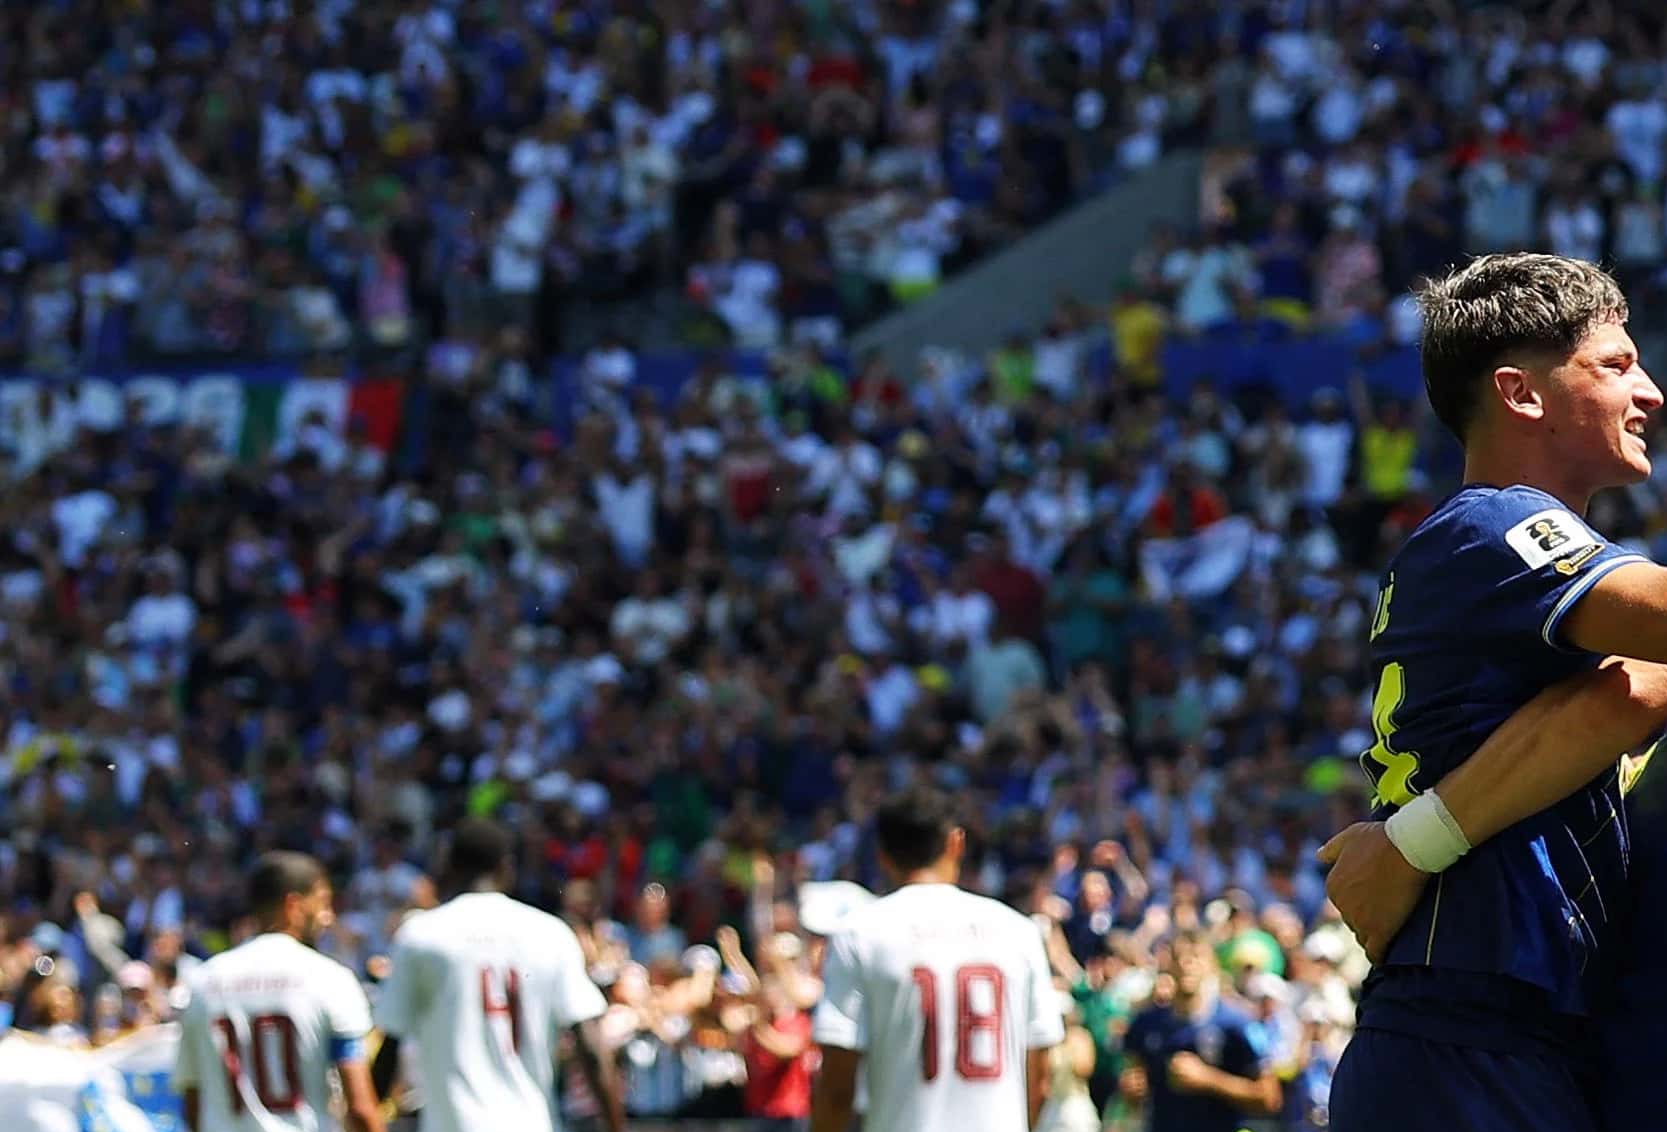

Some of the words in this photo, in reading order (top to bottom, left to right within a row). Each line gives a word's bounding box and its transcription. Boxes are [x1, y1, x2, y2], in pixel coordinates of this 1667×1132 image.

[481, 966, 520, 1056] 4
[912, 964, 1005, 1081] 18
[213, 1014, 301, 1114] 10
